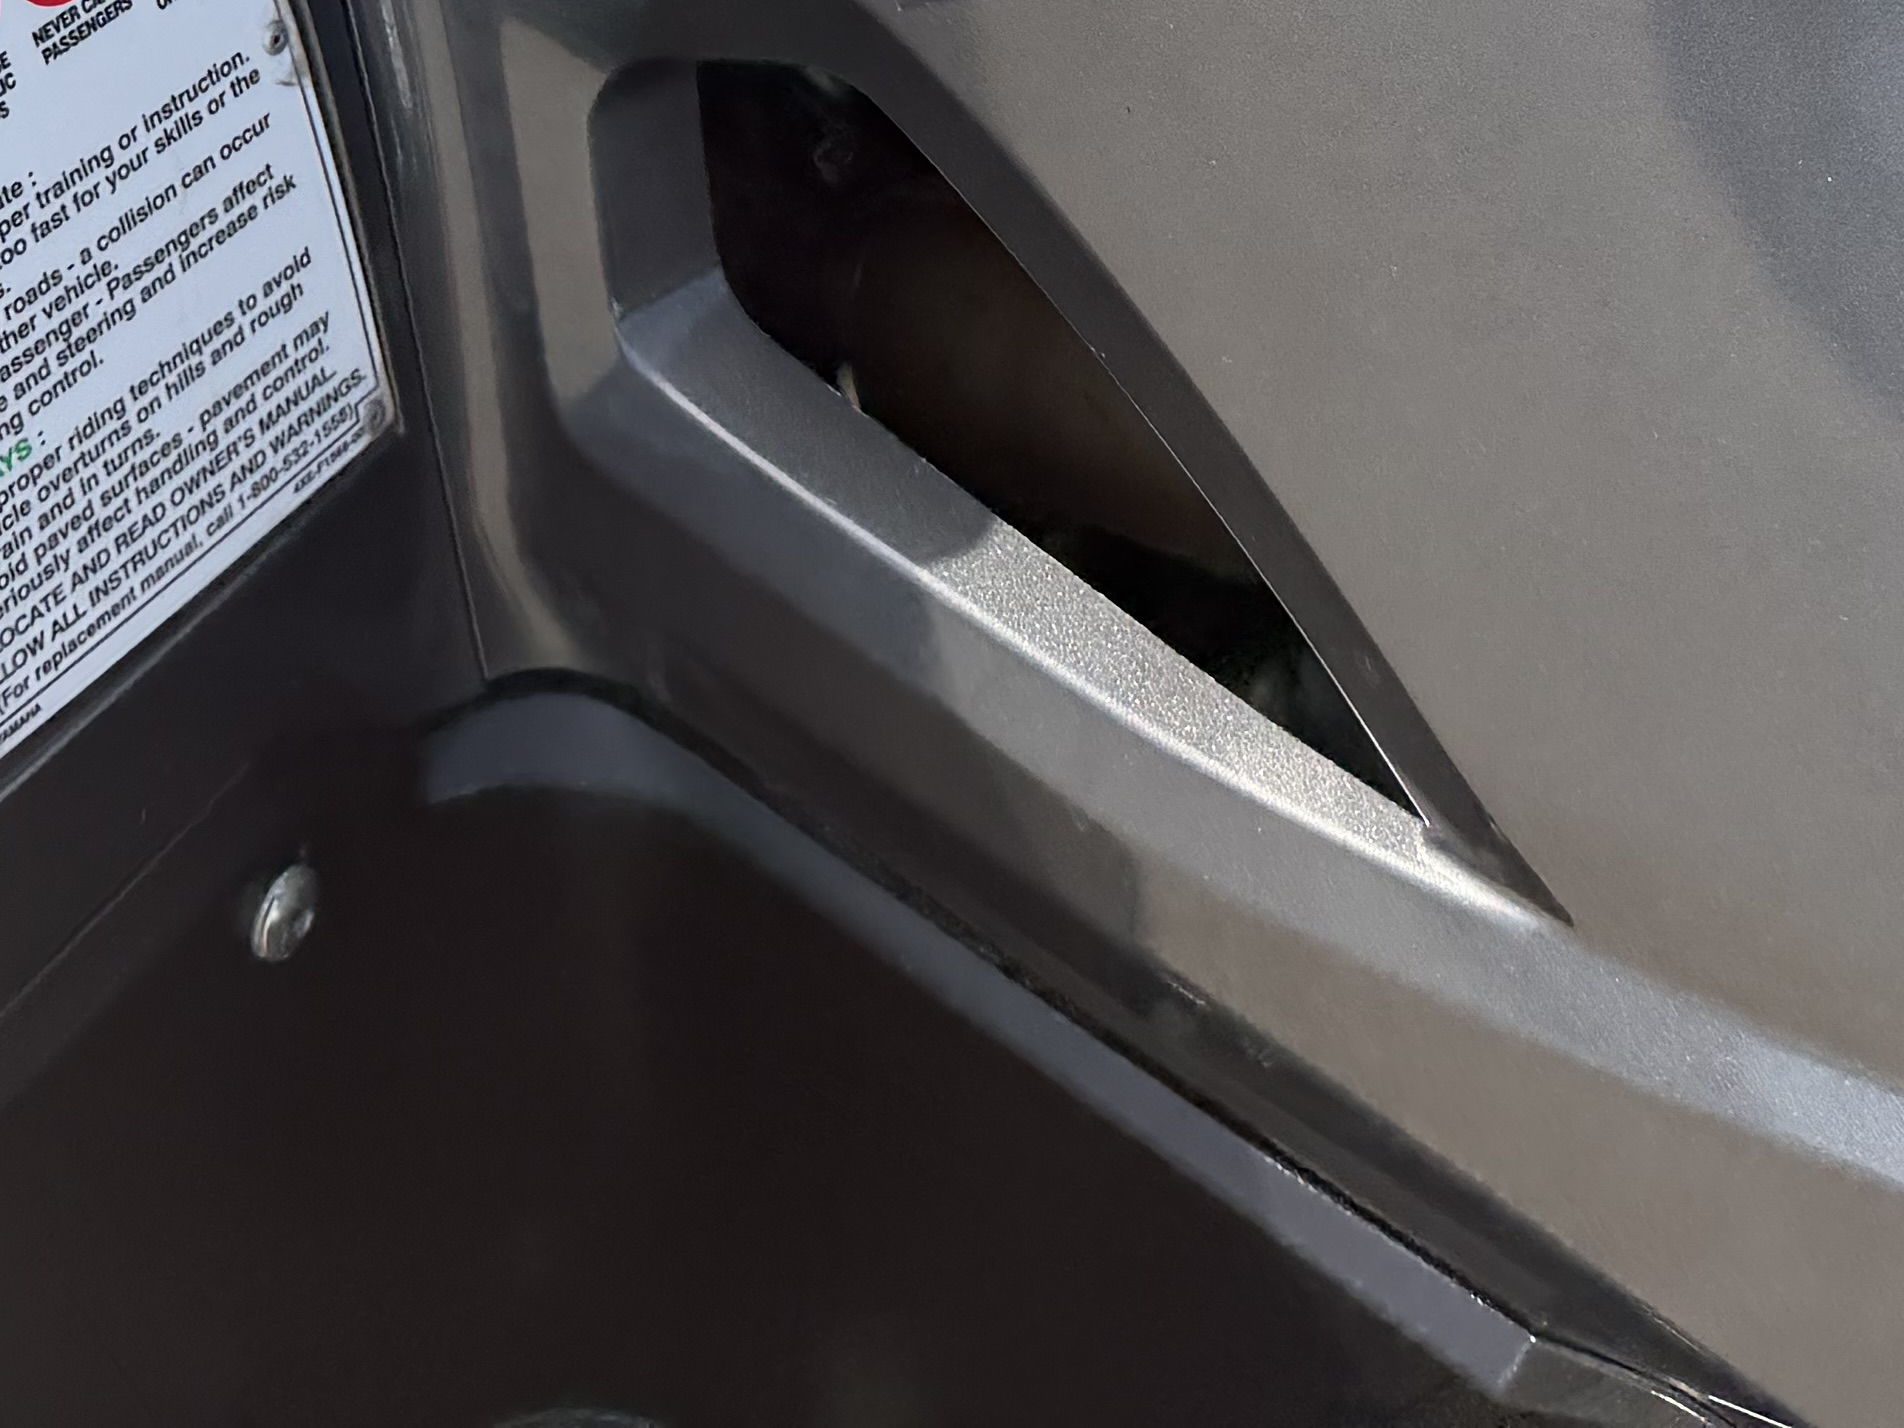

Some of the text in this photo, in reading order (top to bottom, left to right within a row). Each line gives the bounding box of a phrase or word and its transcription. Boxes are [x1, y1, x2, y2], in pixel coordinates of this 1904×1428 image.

[32, 5, 81, 47] NEVER
[31, 204, 70, 243] fast
[73, 182, 100, 213] for
[105, 147, 148, 194] your
[154, 110, 203, 154] skills
[207, 91, 226, 115] or
[230, 69, 260, 98] the
[36, 145, 114, 209] training
[118, 125, 137, 150] or
[142, 52, 250, 133] instruction.
[4, 269, 63, 321] roads
[80, 247, 93, 265] a
[97, 184, 177, 251] collision
[181, 155, 216, 189] can
[220, 113, 270, 160] occur
[42, 261, 119, 319] vehicle.
[51, 603, 87, 642] ALL
[89, 483, 226, 608] INSTRUCTIONS
[230, 449, 267, 492] AND
[269, 368, 367, 455] WARNINGS.
